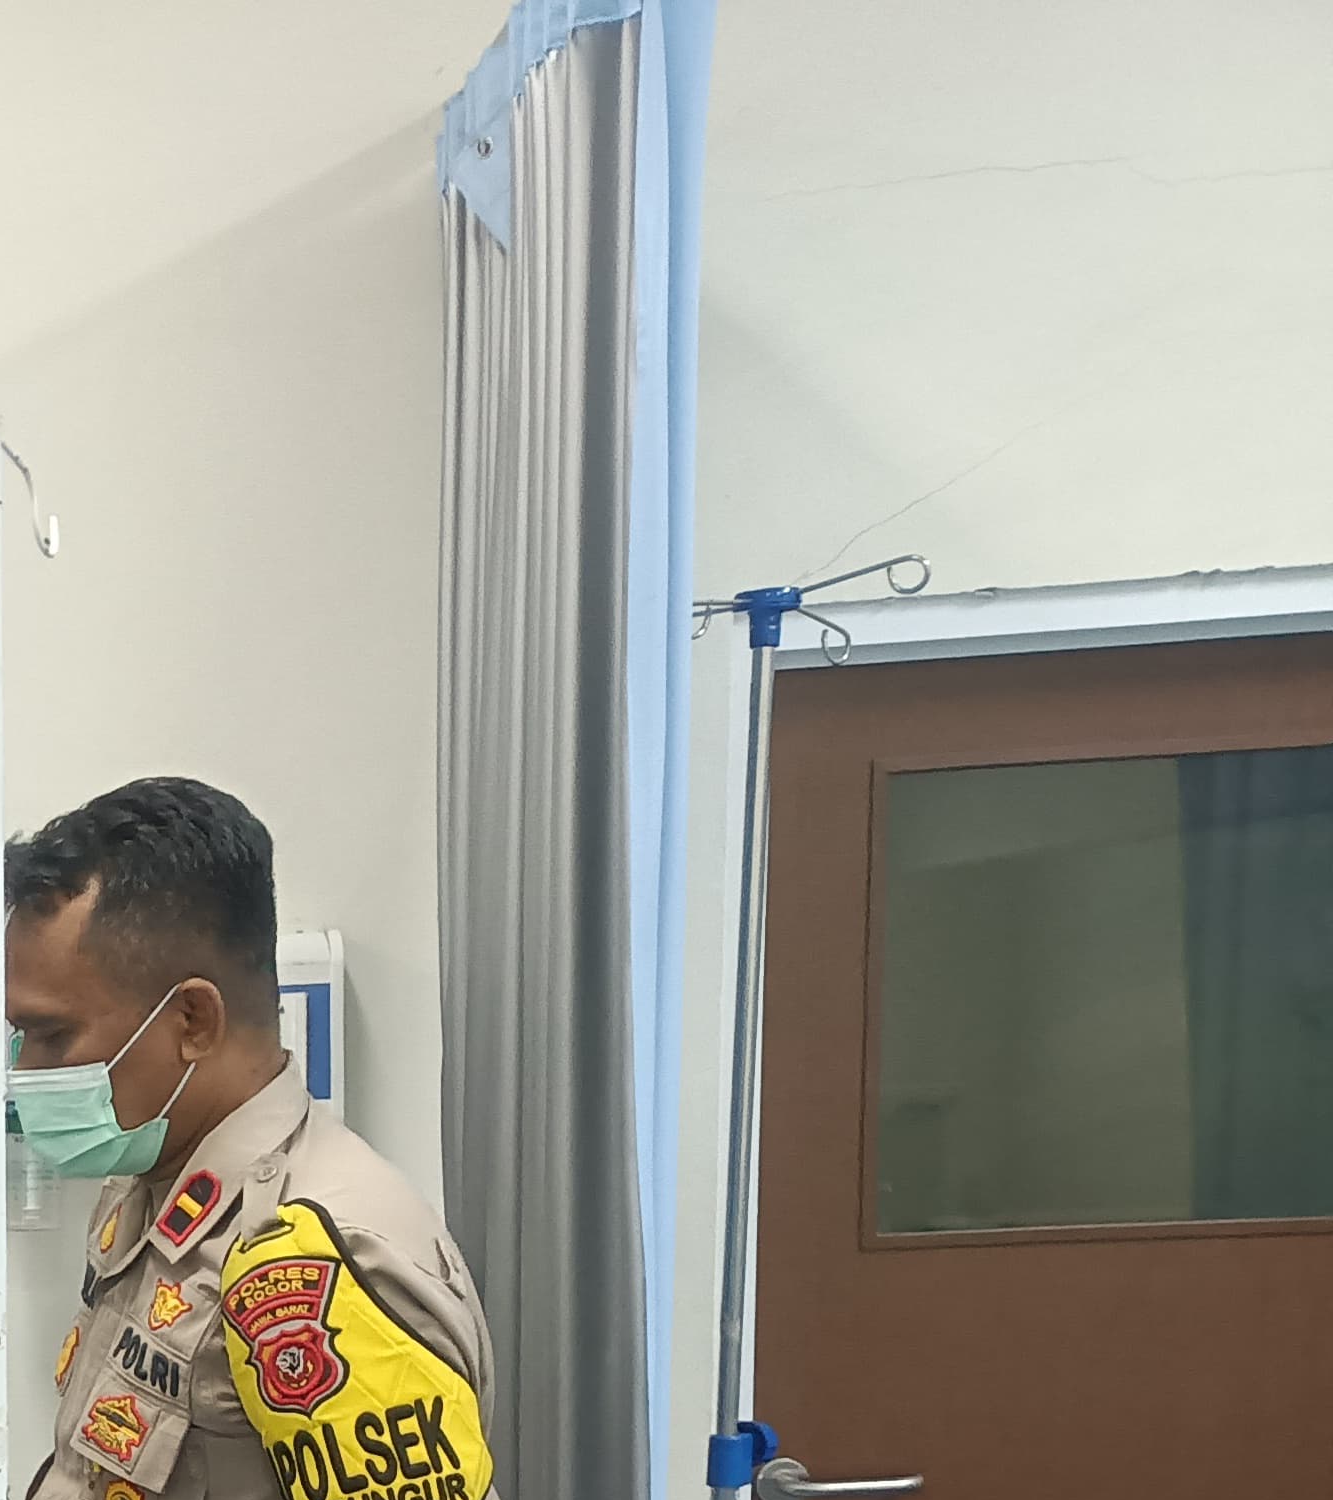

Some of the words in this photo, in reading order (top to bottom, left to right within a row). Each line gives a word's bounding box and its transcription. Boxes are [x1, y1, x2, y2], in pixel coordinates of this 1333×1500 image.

[228, 1266, 321, 1310] POLRES
[243, 1279, 305, 1309] BOGOR
[112, 1326, 180, 1398] POLRI
